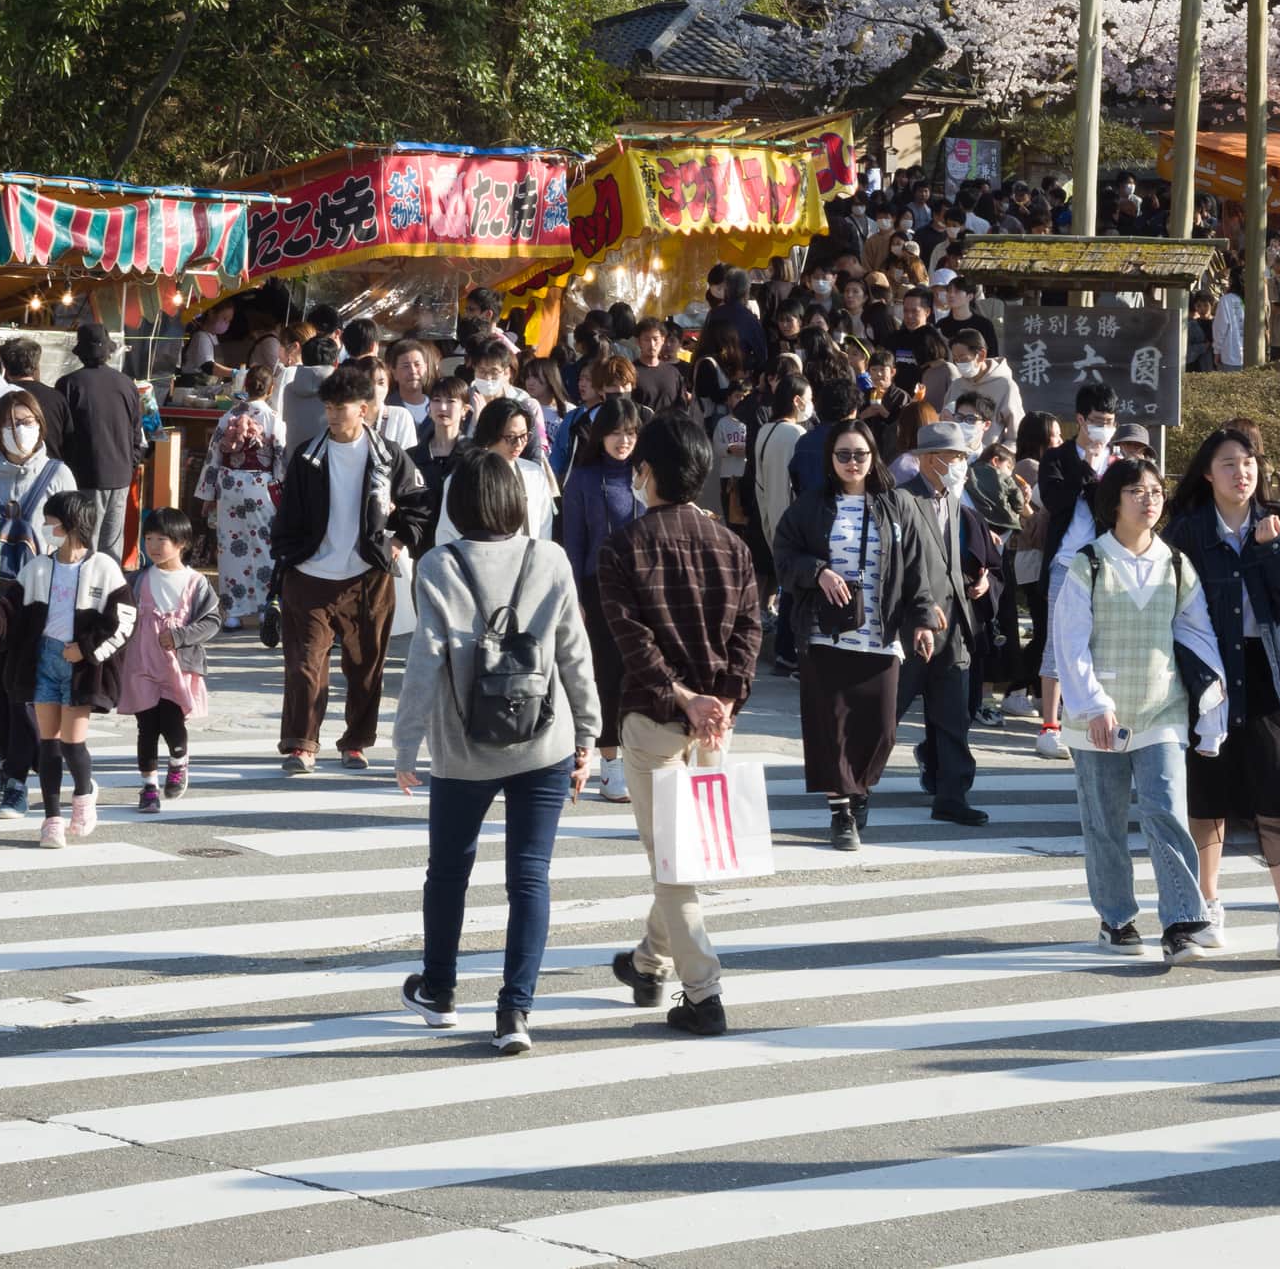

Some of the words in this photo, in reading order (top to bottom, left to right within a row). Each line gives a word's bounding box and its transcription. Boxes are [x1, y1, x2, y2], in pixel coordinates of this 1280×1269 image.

[248, 176, 379, 270] たこ焼
[470, 169, 539, 240] たこ焼
[1023, 313, 1121, 339] 特別名勝
[1019, 338, 1163, 391] 兼六園
